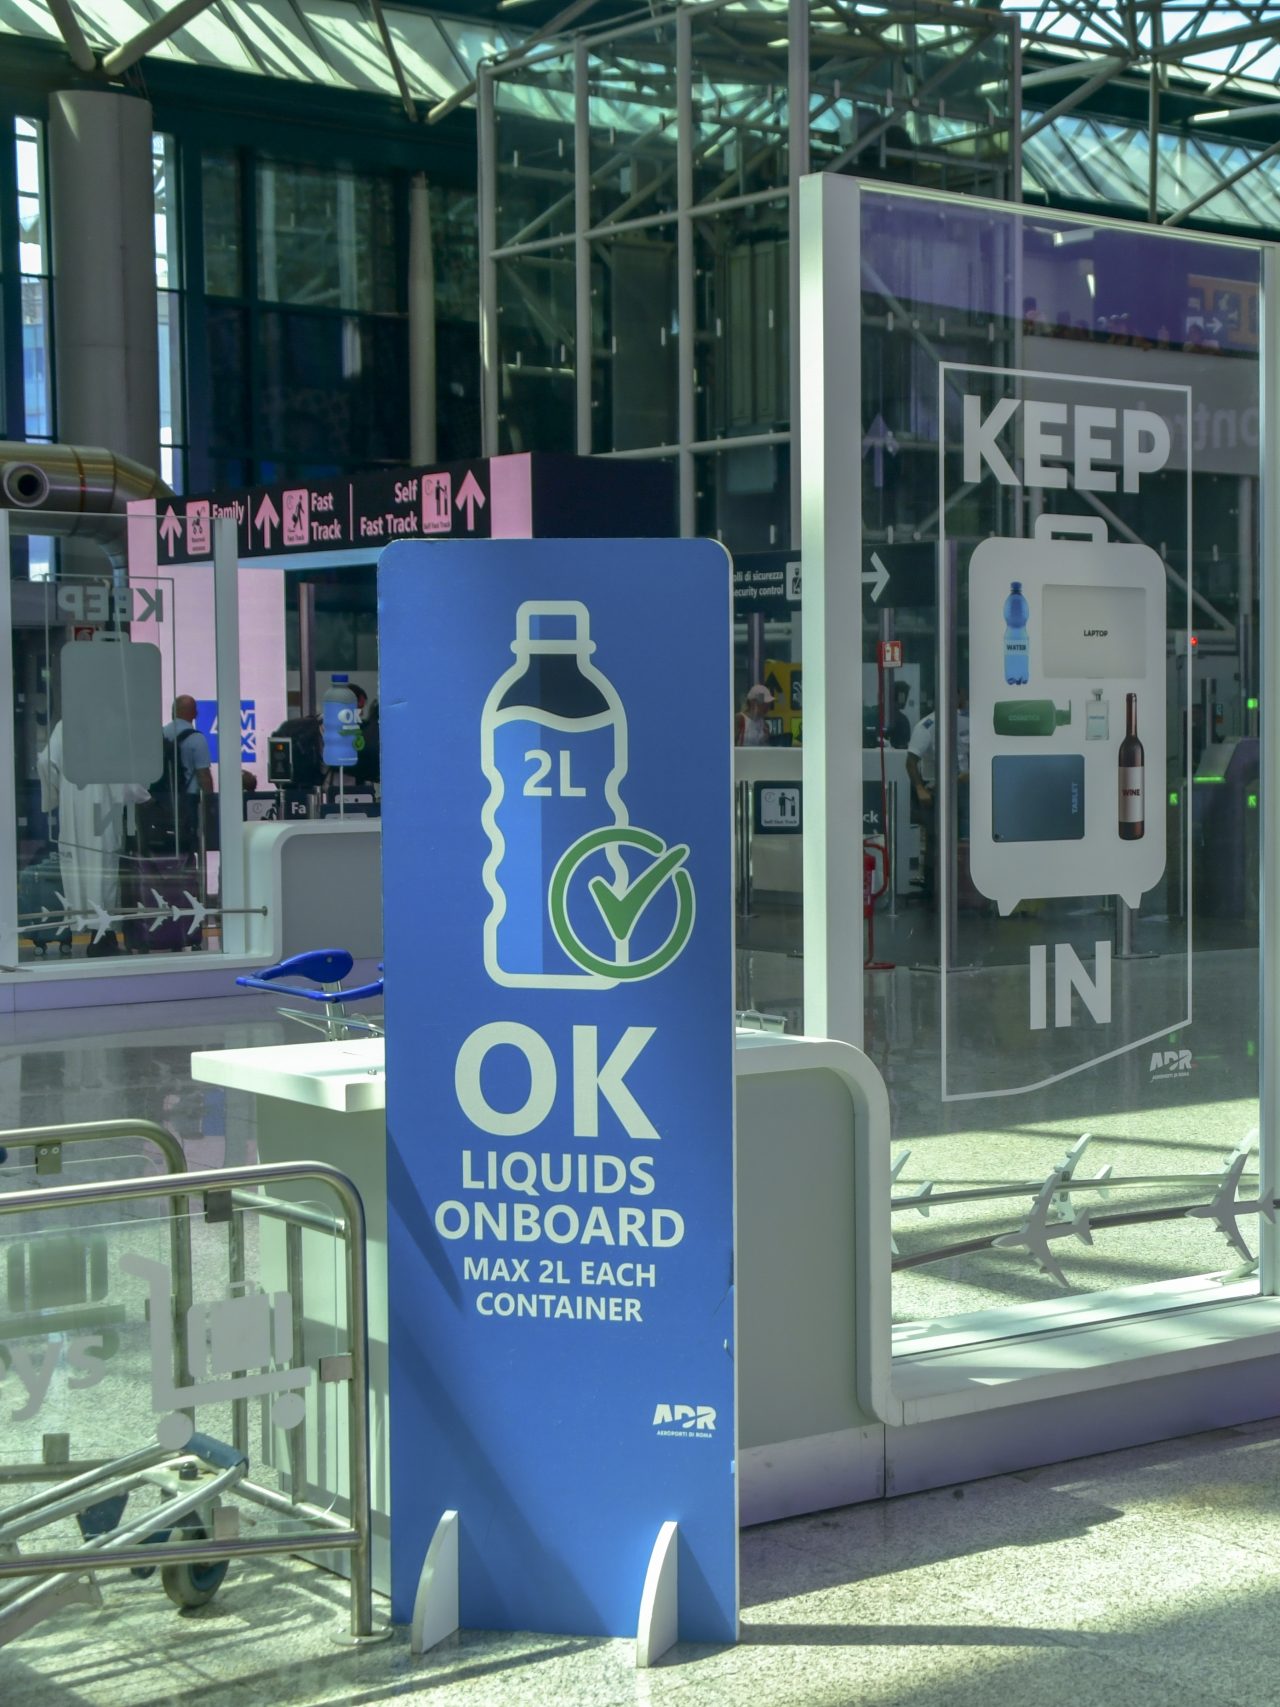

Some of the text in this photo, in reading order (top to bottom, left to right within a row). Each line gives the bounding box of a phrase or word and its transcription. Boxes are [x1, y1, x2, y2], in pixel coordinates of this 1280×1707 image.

[963, 394, 1171, 493] KEEP
[311, 492, 334, 512] Fast
[394, 479, 418, 503] Self
[212, 501, 245, 521] Family
[360, 510, 418, 537] Fast Track
[311, 518, 342, 541] Track
[753, 571, 783, 581] sicurezza
[732, 584, 783, 599] ecurity control
[337, 709, 363, 725] OK
[522, 750, 587, 797] 2L
[1030, 941, 1111, 1030] IN
[1149, 1049, 1192, 1072] ADR
[454, 1020, 661, 1139] OK
[462, 1149, 656, 1196] LIQUIDS
[434, 1199, 685, 1248] ONBOARD
[463, 1256, 656, 1288] MAX 2L EACH
[475, 1291, 643, 1322] CONTAINER
[652, 1403, 717, 1430] ADR
